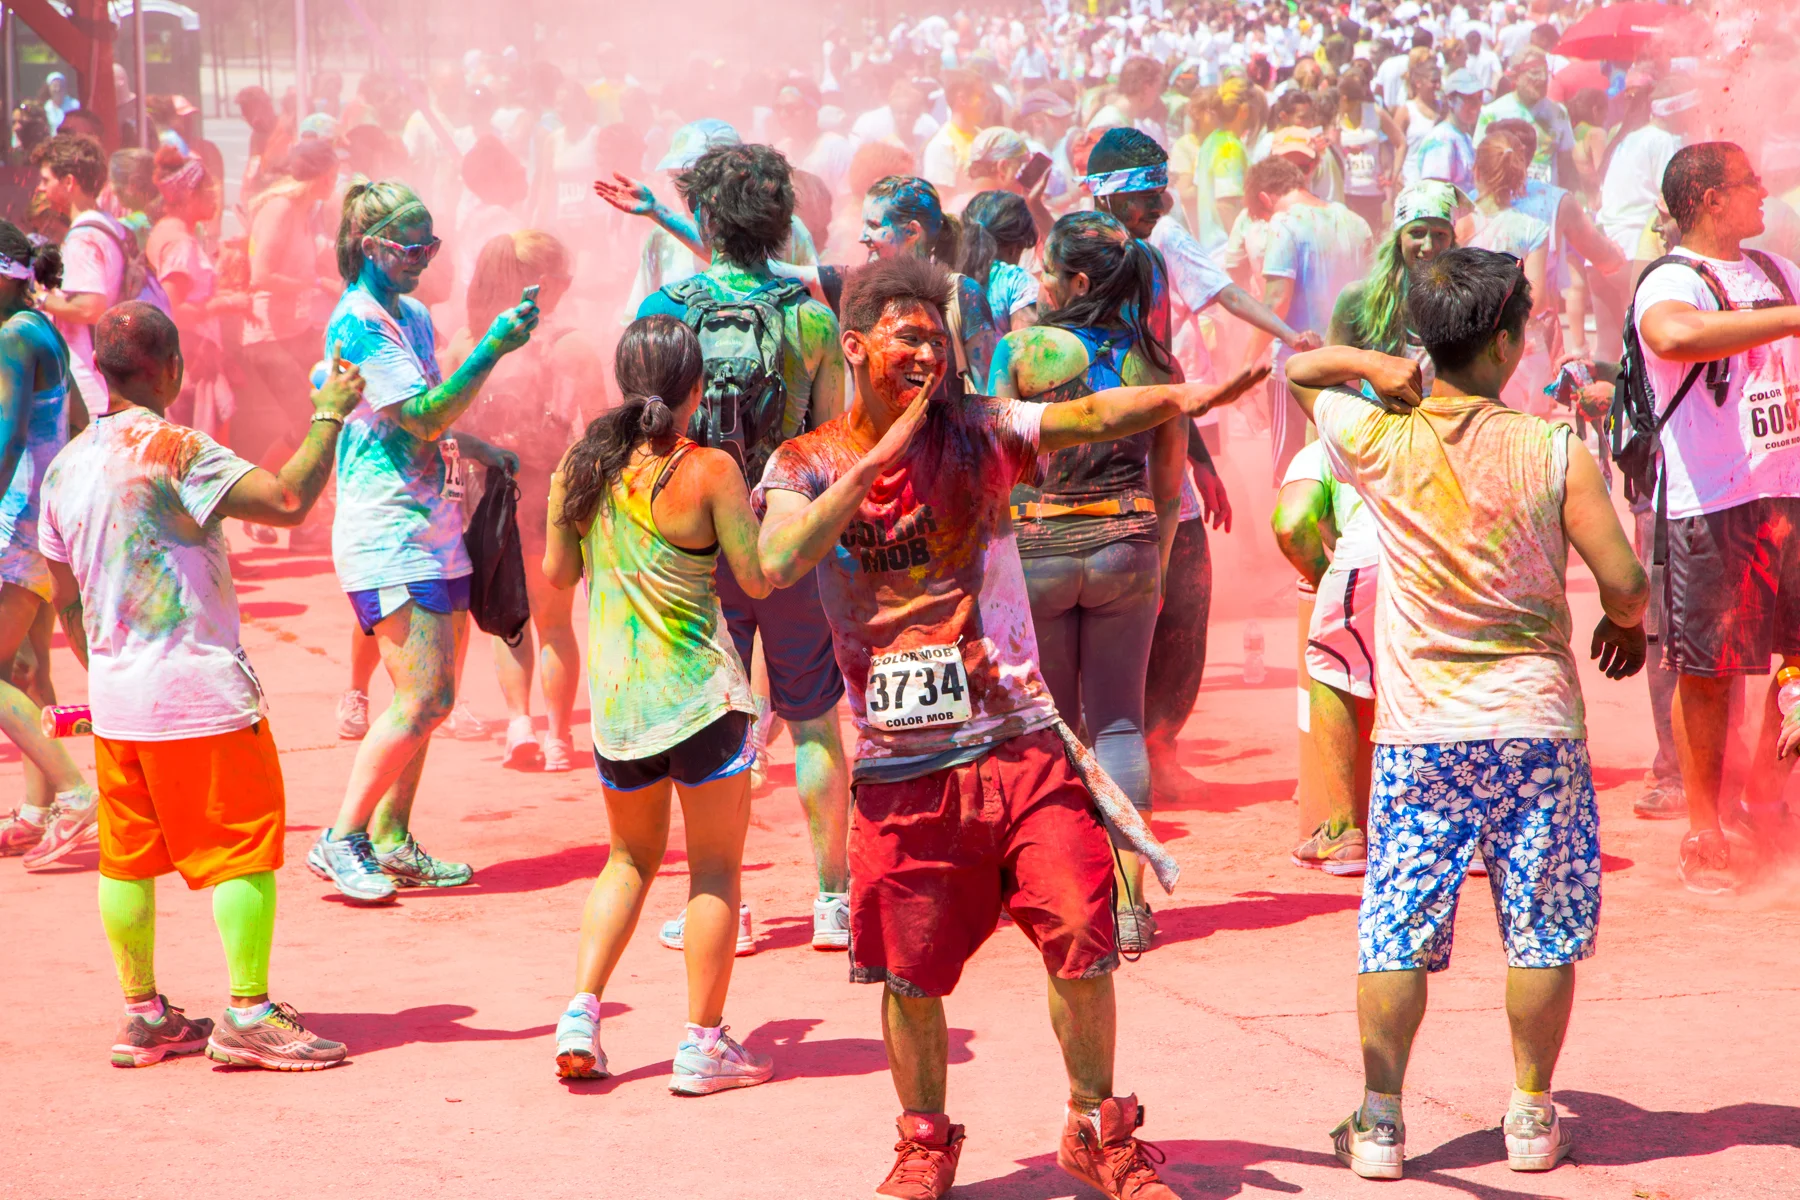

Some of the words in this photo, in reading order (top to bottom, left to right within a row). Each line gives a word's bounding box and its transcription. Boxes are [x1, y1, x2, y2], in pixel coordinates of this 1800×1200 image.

[1749, 388, 1782, 402] COLOR
[1765, 438, 1790, 450] COLOR
[840, 505, 938, 548] COLOR
[861, 537, 931, 574] MOB
[872, 651, 919, 667] COLOR
[919, 648, 953, 661] MOB
[869, 662, 964, 712] 3734
[886, 715, 924, 728] COLOR
[926, 711, 954, 723] MOB
